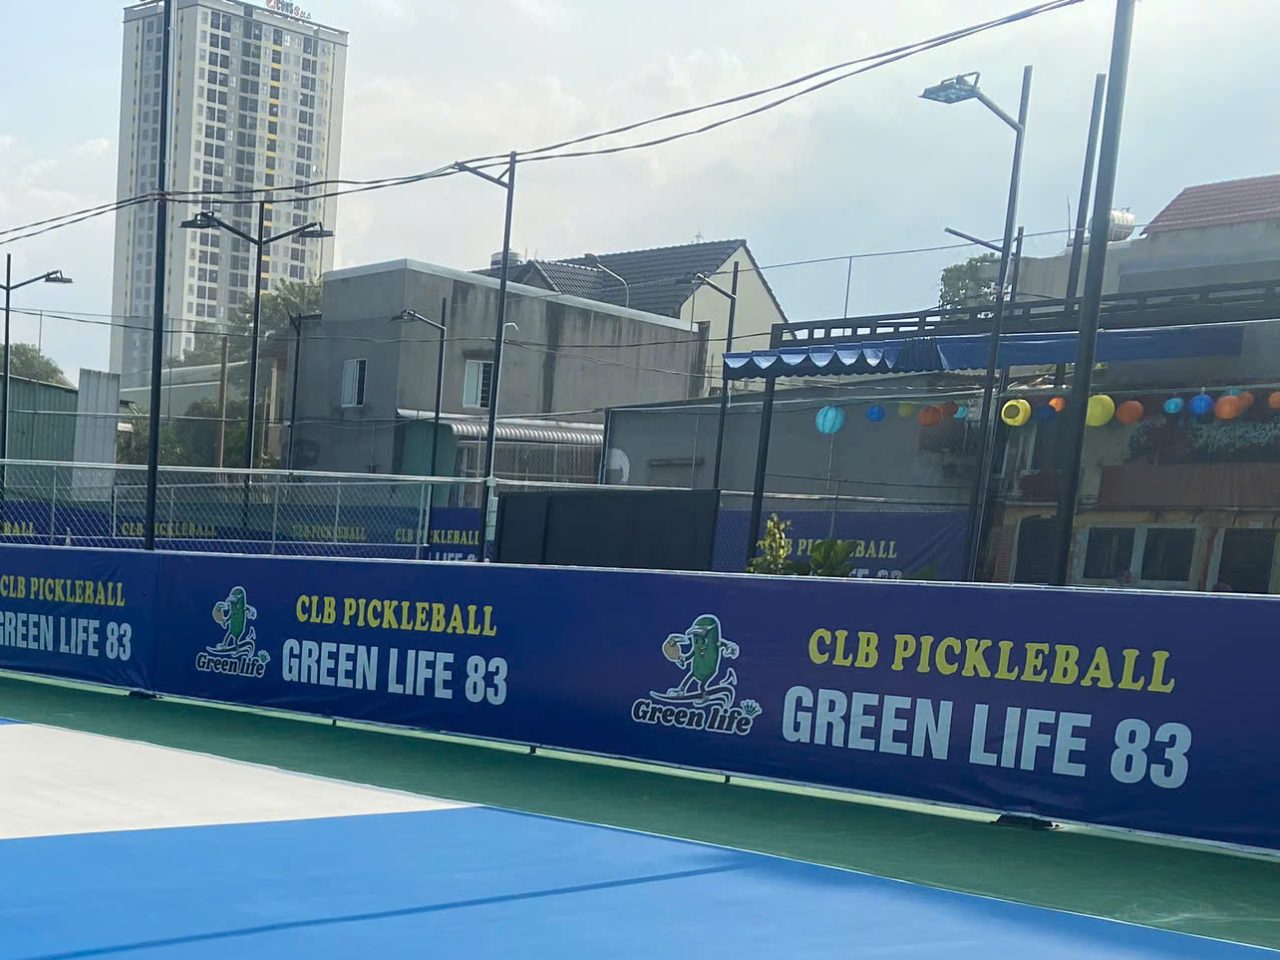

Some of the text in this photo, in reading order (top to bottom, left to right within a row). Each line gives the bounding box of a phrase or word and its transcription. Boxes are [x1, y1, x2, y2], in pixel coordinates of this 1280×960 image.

[154, 523, 217, 537] ICKLEBALL
[0, 575, 125, 606] CLB PICKLEBALL
[296, 595, 497, 636] CLB PICKLEBALL
[59, 617, 100, 657] LIFE
[106, 621, 131, 661] 83
[196, 652, 265, 678] Green life
[282, 638, 508, 705] GREEN LIFE 83
[808, 628, 1176, 693] CLB PICKLEBALL
[631, 699, 755, 736] Green life
[782, 686, 1192, 789] GREEN LIFE 83
